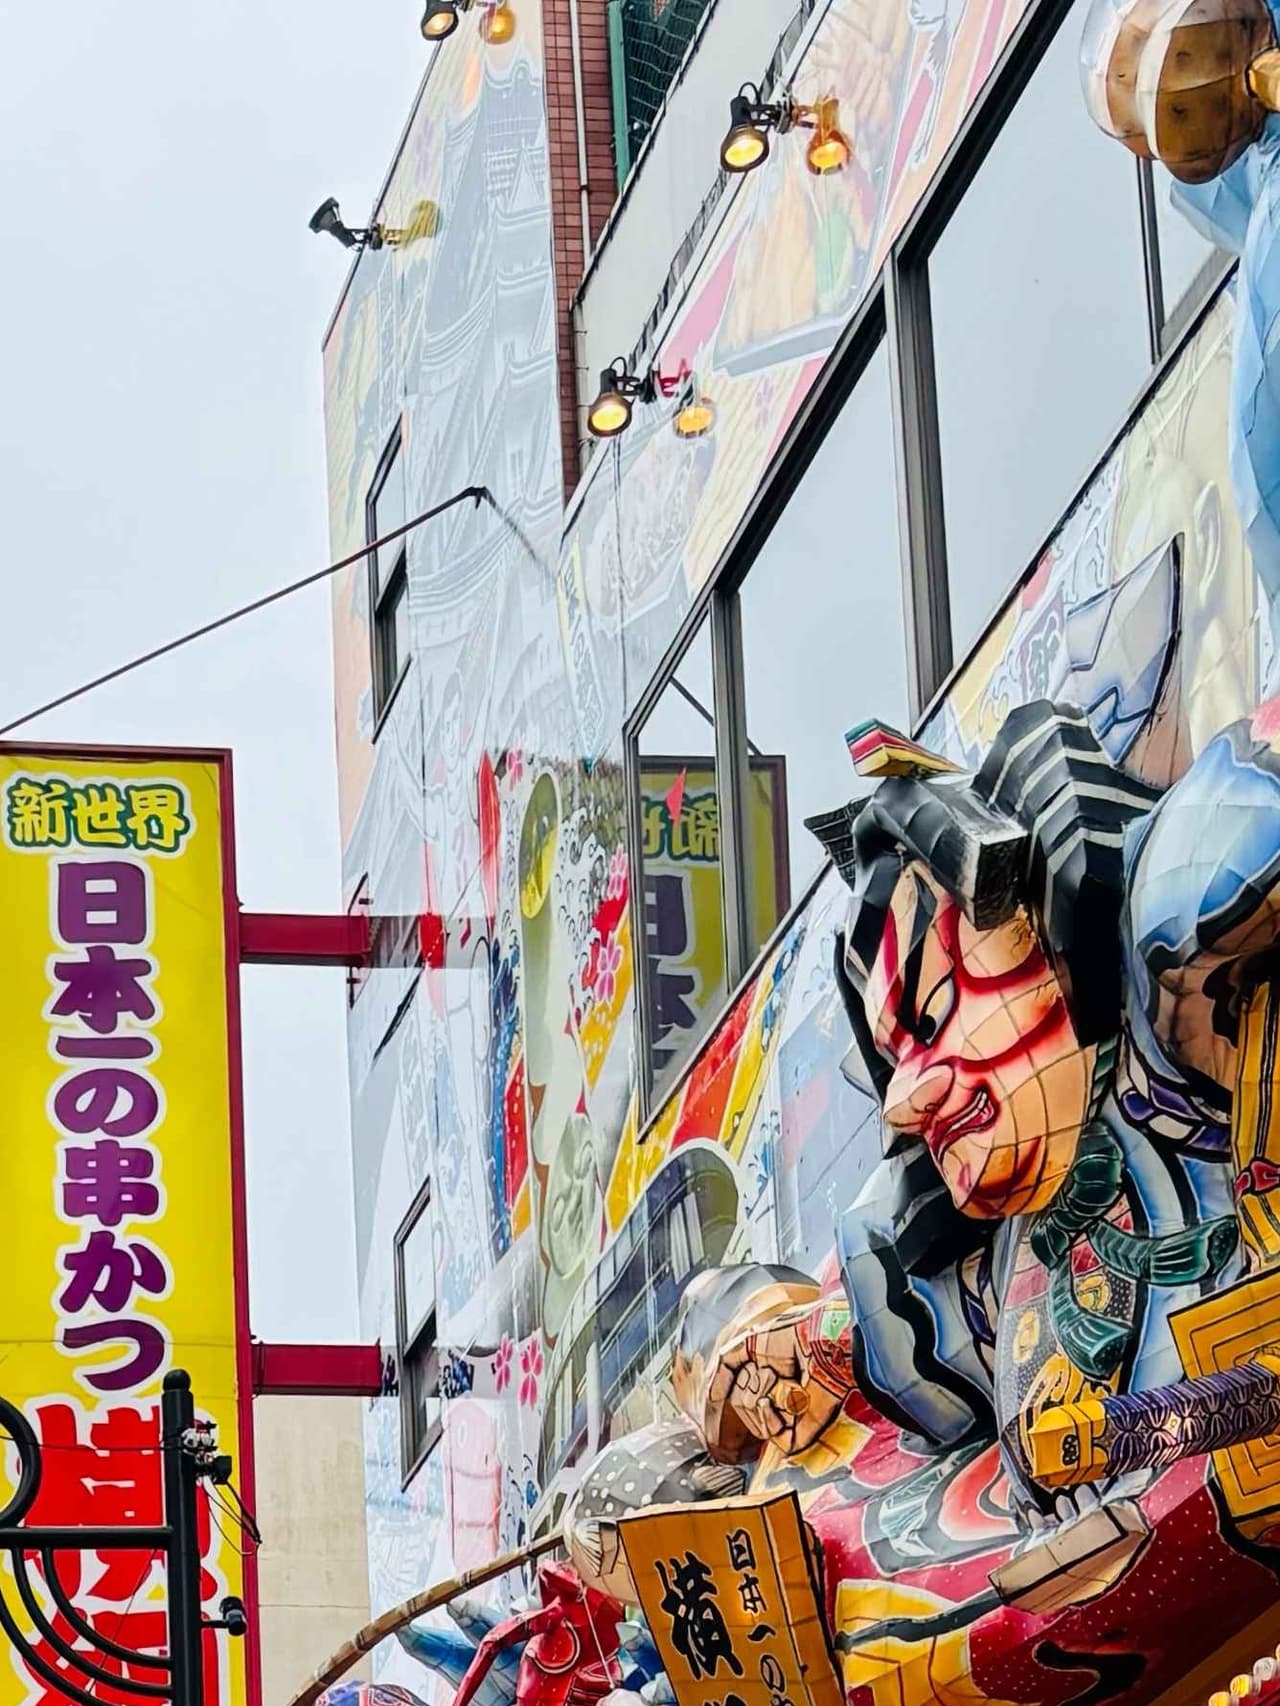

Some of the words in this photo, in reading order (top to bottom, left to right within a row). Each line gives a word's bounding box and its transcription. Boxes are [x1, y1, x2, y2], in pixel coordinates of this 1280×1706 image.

[8, 780, 190, 850] 新世界
[52, 860, 168, 1392] 日本一の串かつ
